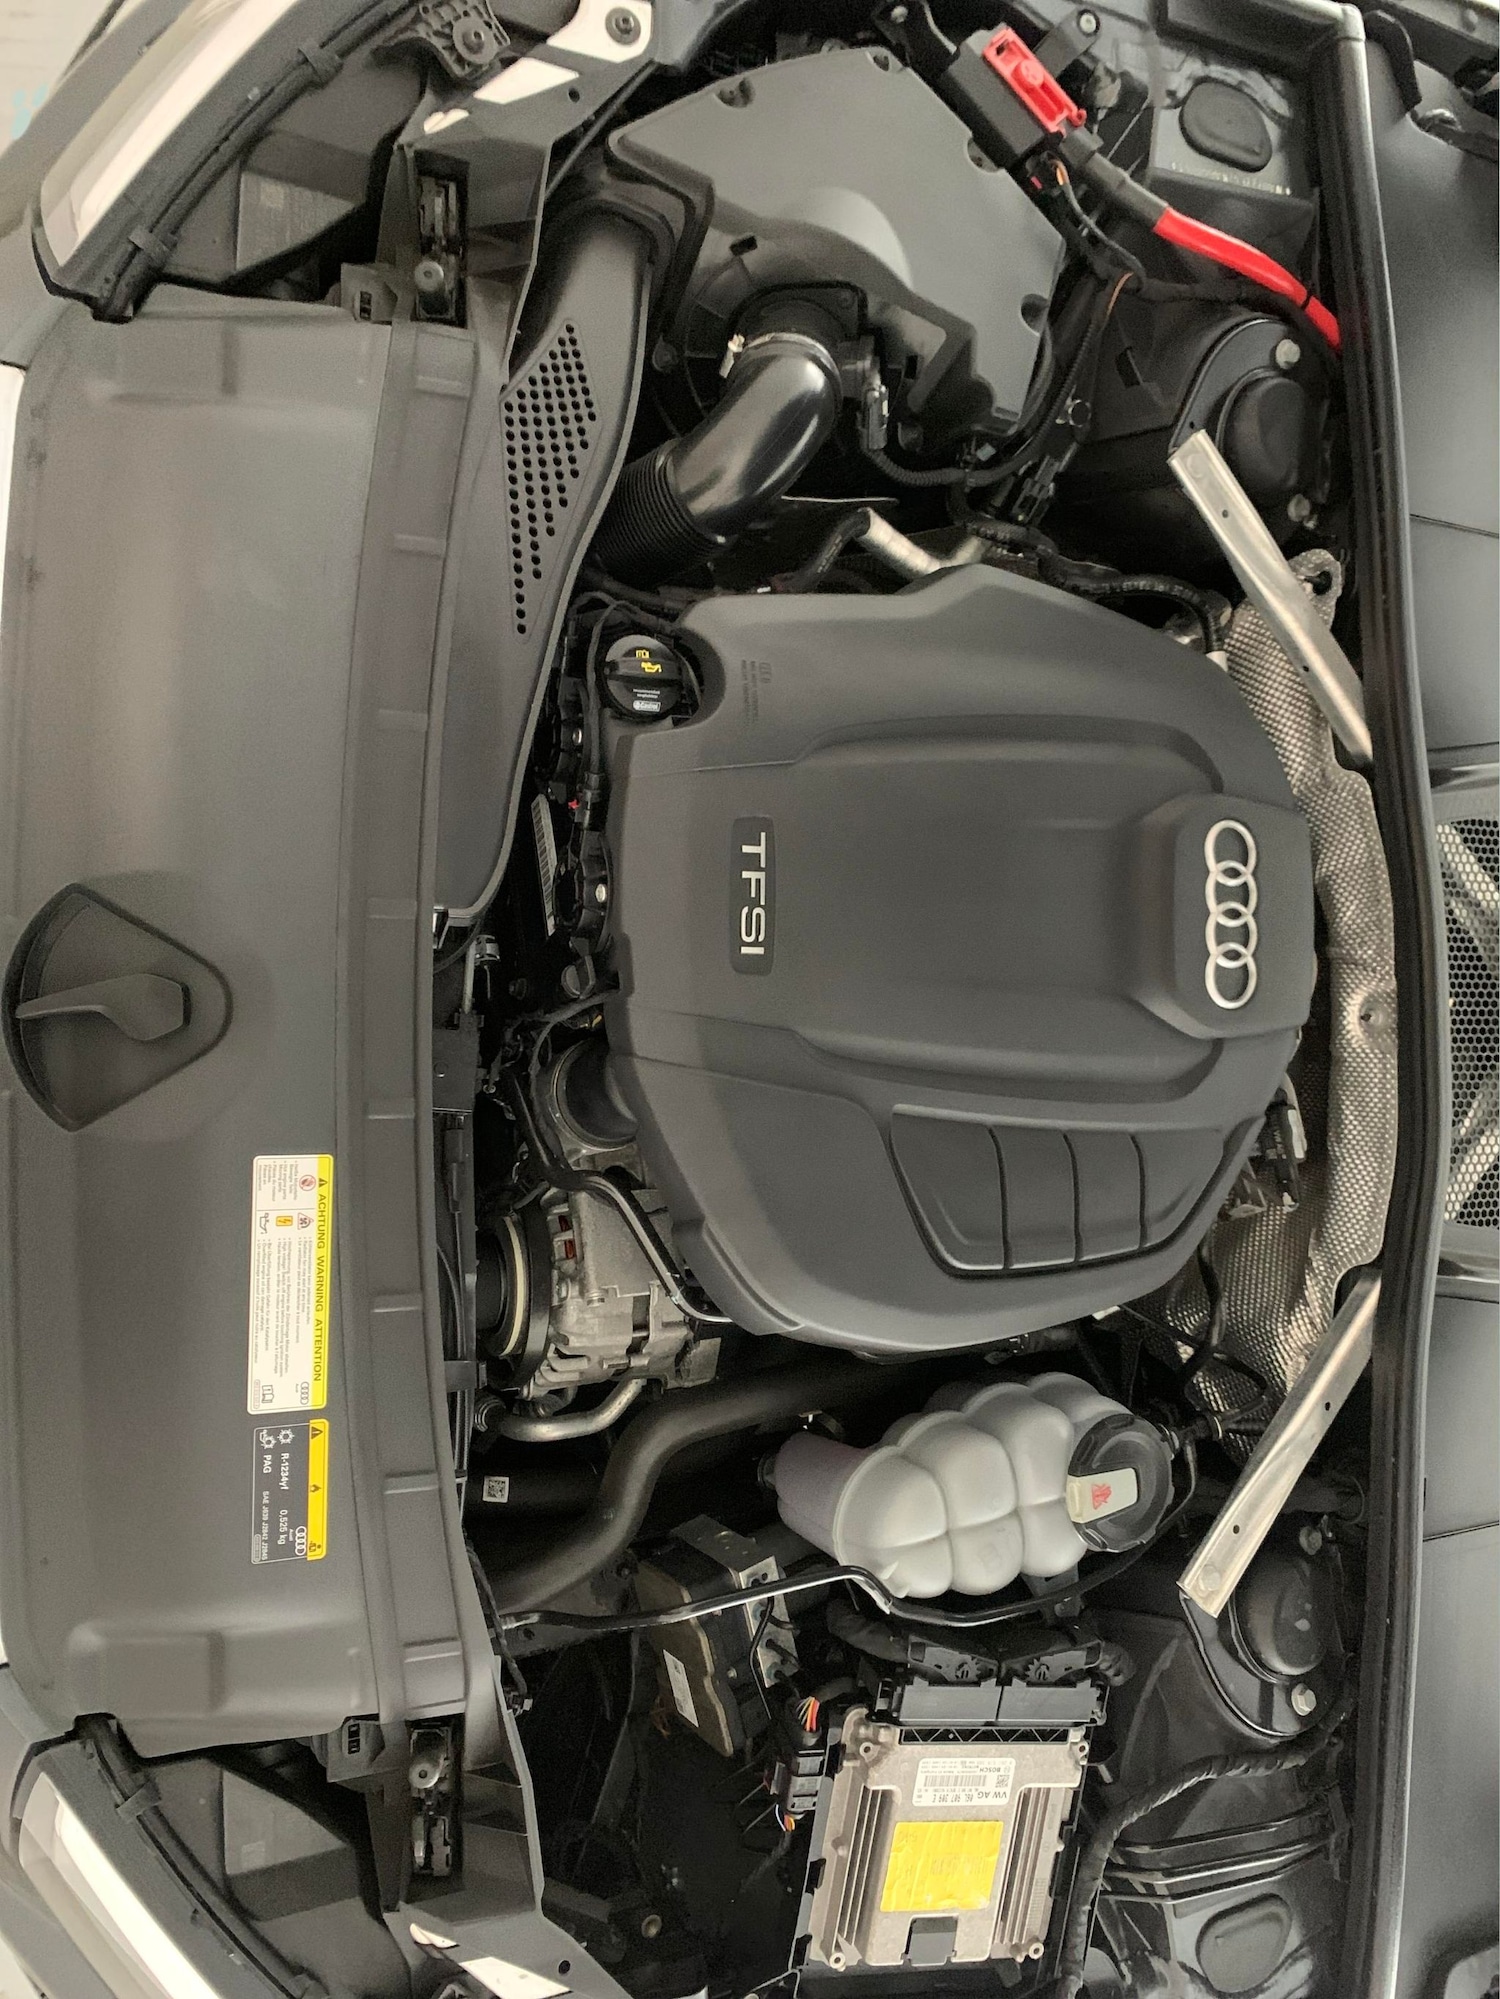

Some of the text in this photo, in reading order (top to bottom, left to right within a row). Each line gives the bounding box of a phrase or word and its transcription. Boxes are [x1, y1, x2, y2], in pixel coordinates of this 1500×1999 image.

[740, 831, 766, 955] TFSI
[314, 1194, 327, 1382] ACHTUNG WARNING ATTENTION
[263, 1455, 272, 1473] PAG
[278, 1453, 290, 1490] R-1234yf
[262, 1491, 270, 1504] SAE
[277, 1534, 288, 1545] kg
[977, 1791, 991, 1799] AG
[992, 1791, 1007, 1799] VW
